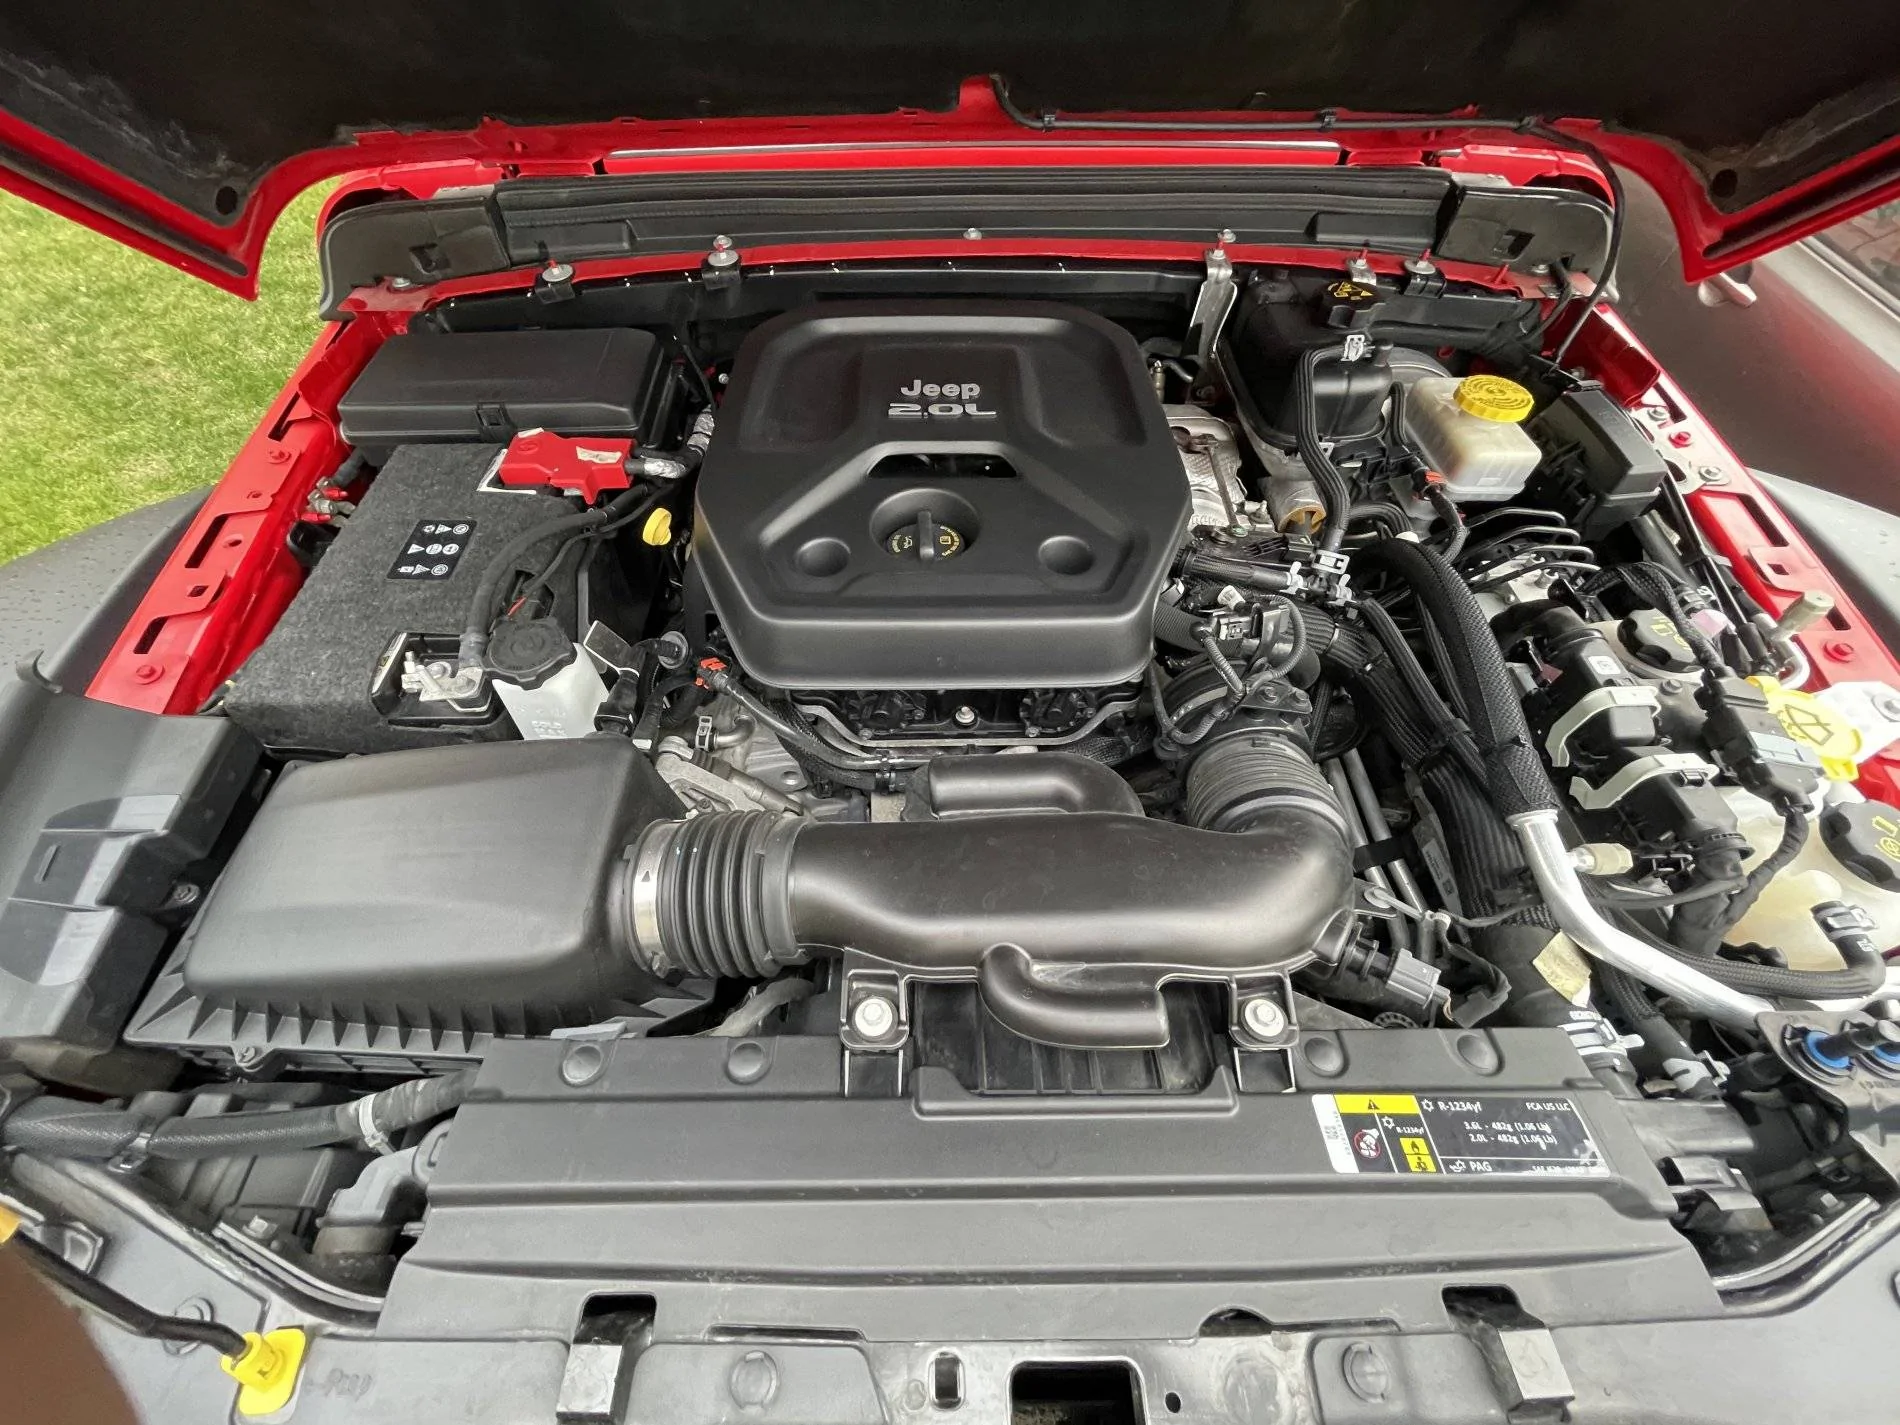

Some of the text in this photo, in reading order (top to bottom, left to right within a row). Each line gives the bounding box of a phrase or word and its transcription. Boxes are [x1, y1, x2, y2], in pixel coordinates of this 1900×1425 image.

[900, 379, 981, 400] Jeep
[888, 402, 997, 418] 2.0L
[1438, 1102, 1483, 1113] R-1234yf
[1525, 1102, 1571, 1112] FCA US LLC
[1469, 1161, 1493, 1172] PAG
